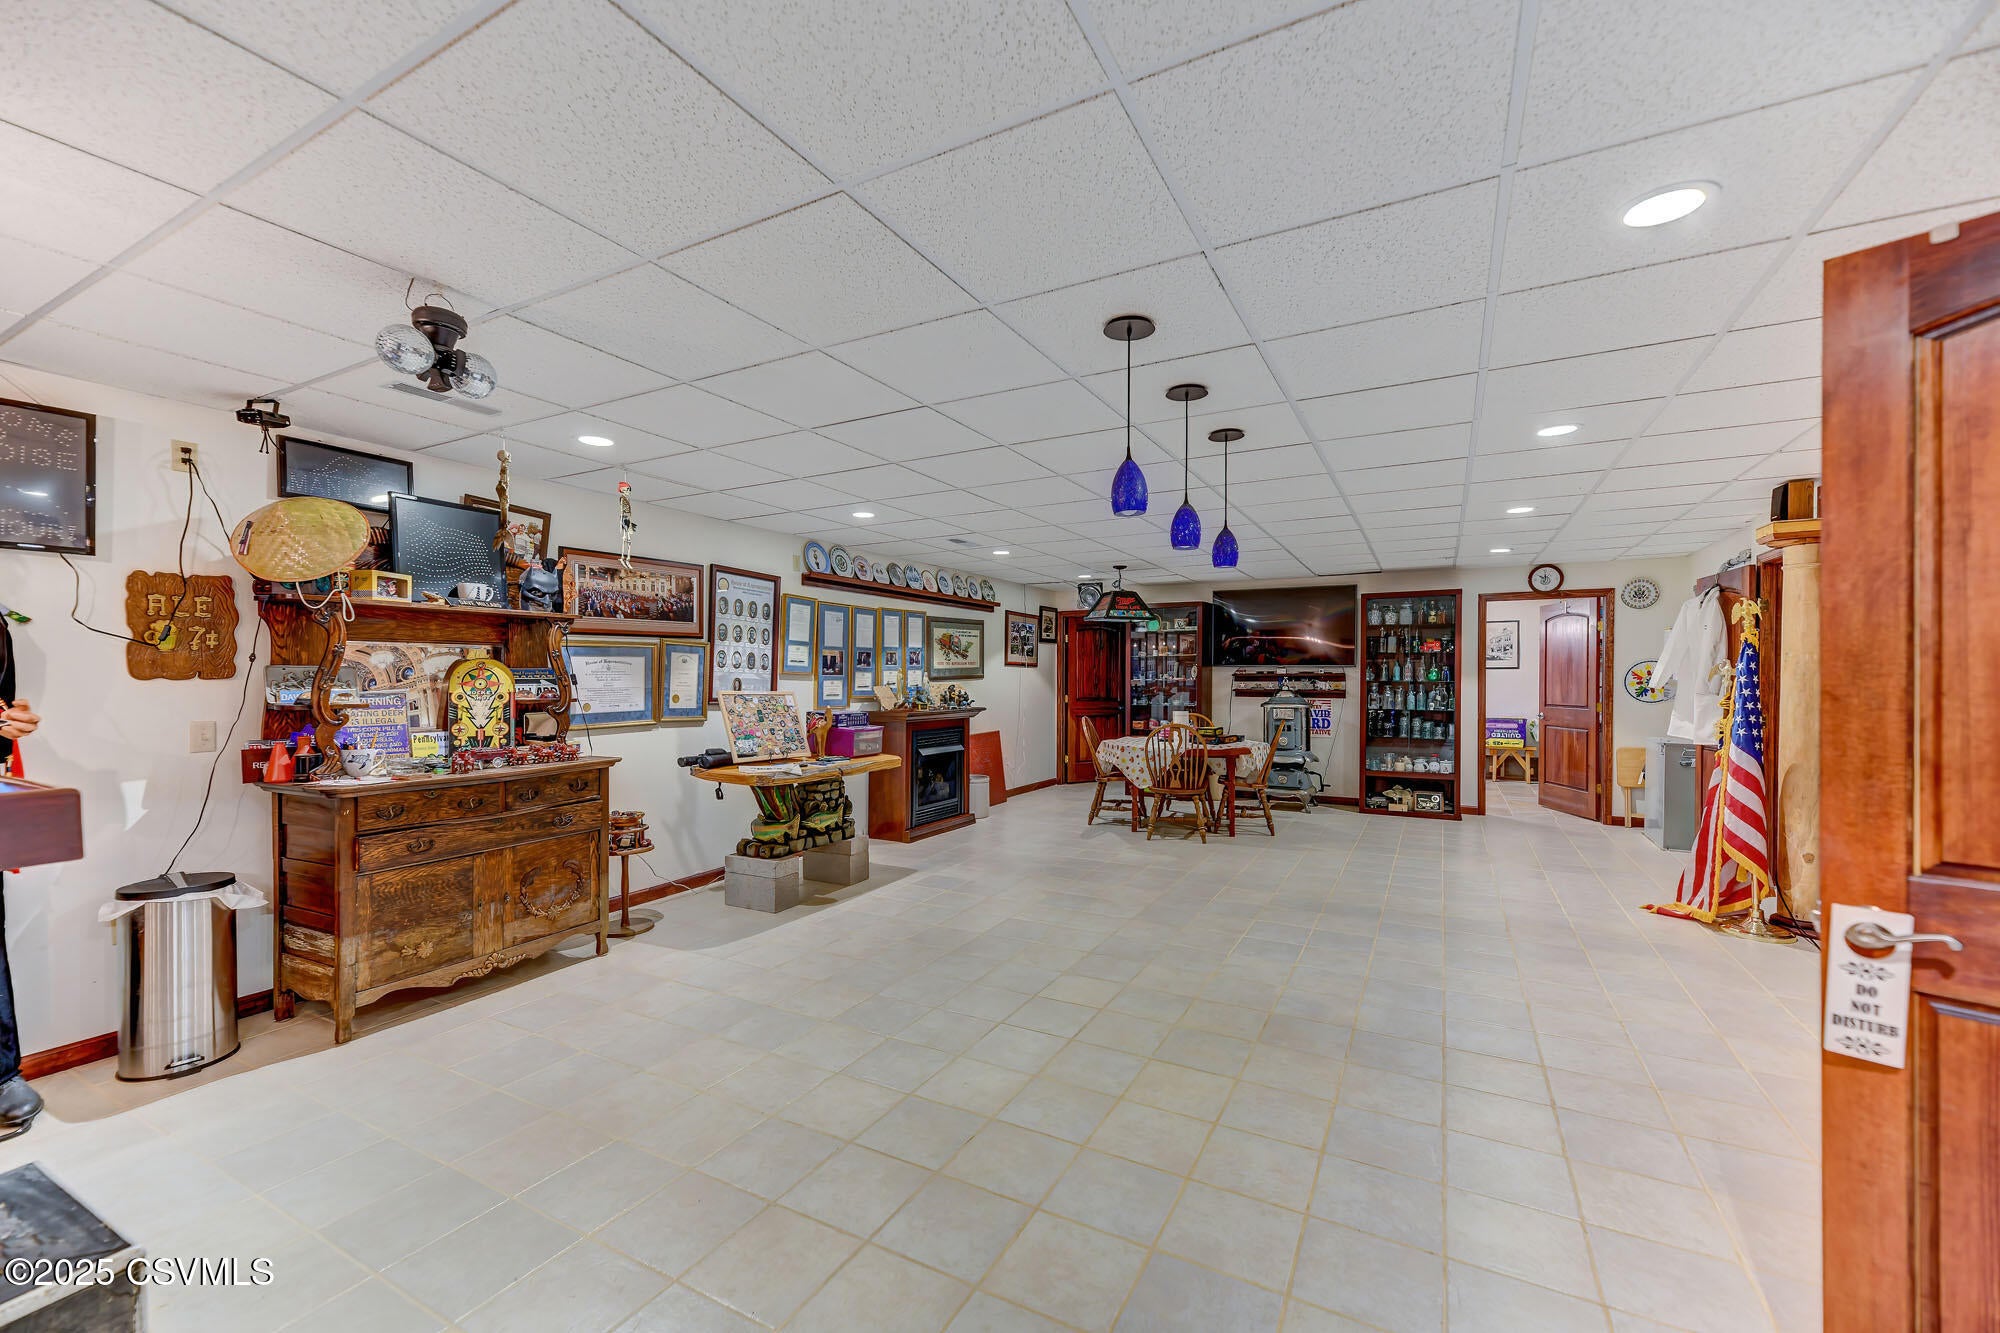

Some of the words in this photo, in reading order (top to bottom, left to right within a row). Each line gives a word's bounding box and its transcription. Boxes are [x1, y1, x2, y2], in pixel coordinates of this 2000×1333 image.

[146, 593, 212, 618] ALE
[281, 692, 300, 702] DAV
[360, 697, 402, 706] ARNING
[350, 710, 379, 718] AITING
[1857, 984, 1877, 998] DO
[1851, 1000, 1882, 1016] NOT
[1832, 1013, 1899, 1038] DISTURB
